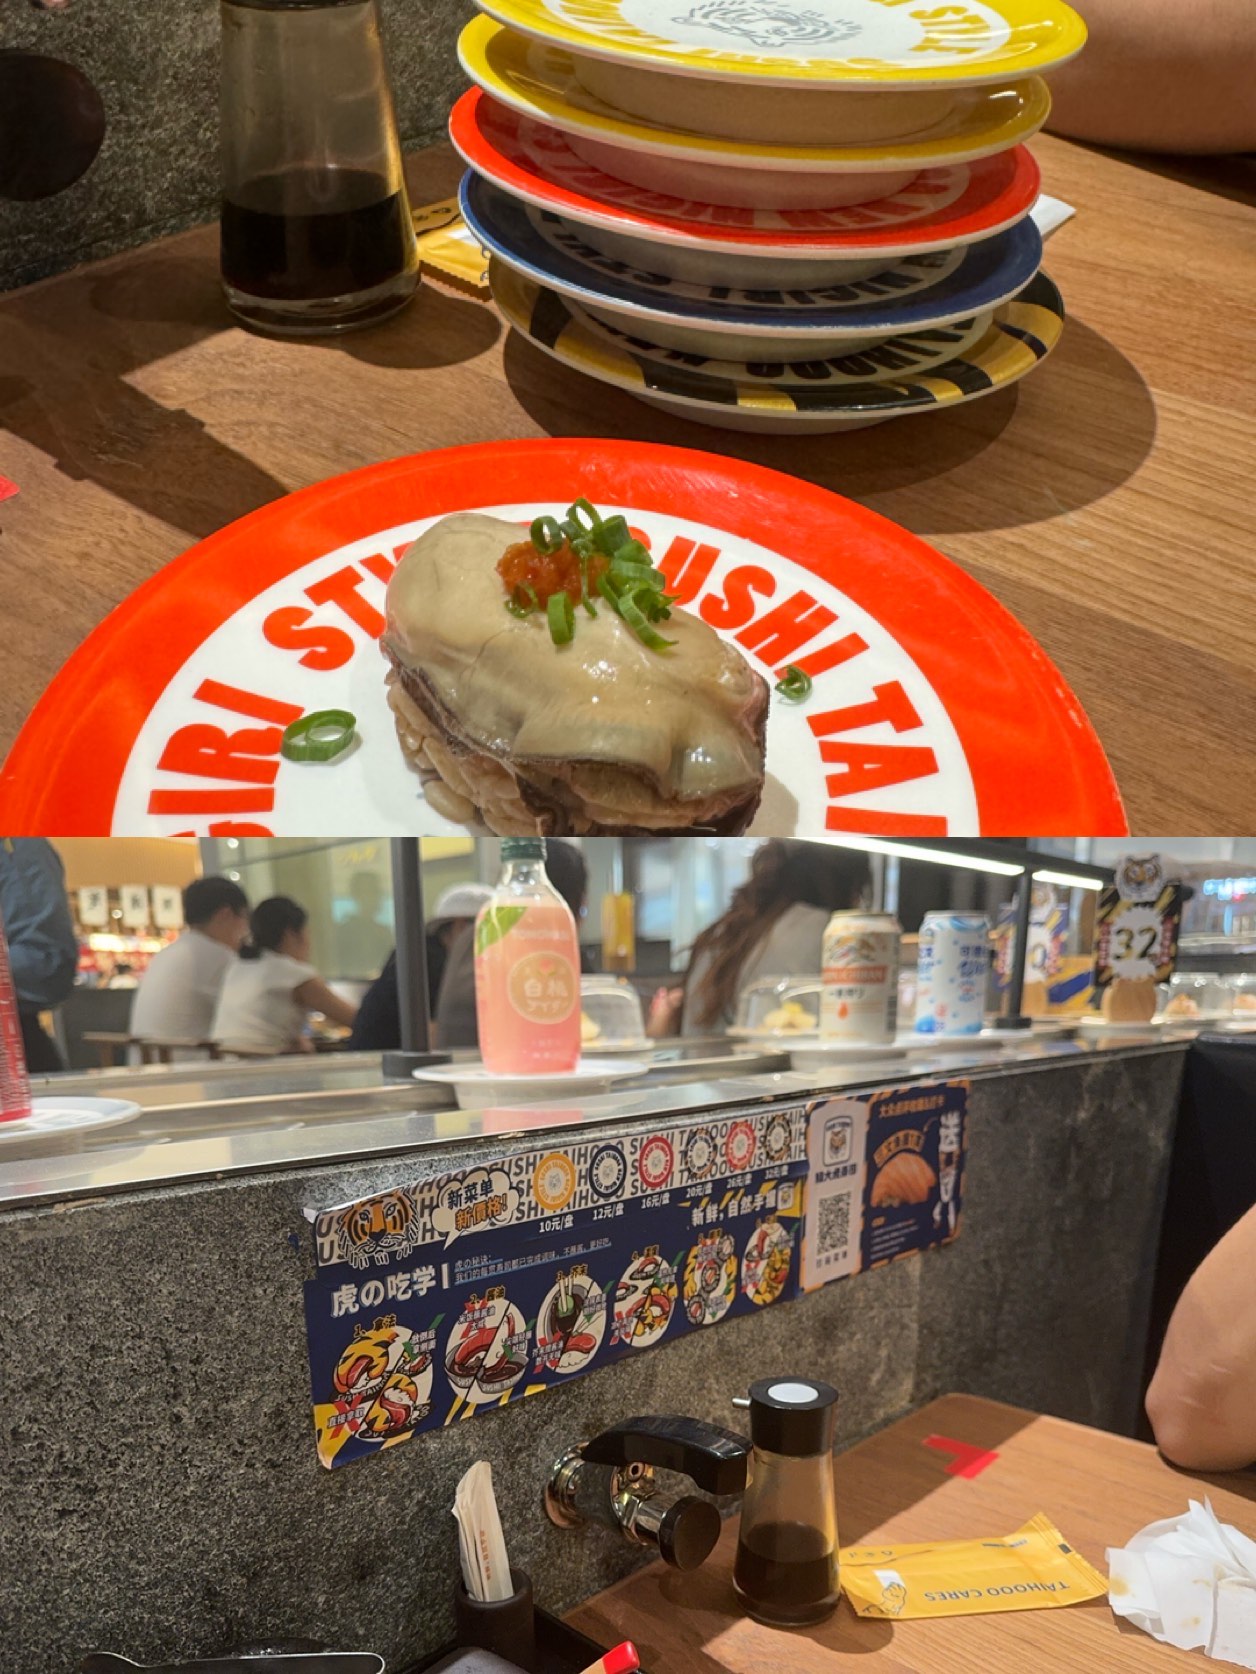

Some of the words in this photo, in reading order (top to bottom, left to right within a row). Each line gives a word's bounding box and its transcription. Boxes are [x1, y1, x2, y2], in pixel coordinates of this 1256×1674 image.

[628, 526, 870, 681] USHI
[1113, 927, 1157, 961] 32
[448, 1179, 494, 1210] 新菜单
[331, 1265, 437, 1318] 虎の吃学
[924, 1588, 983, 1602] CARES
[987, 1581, 1070, 1596] TAIHOOO
